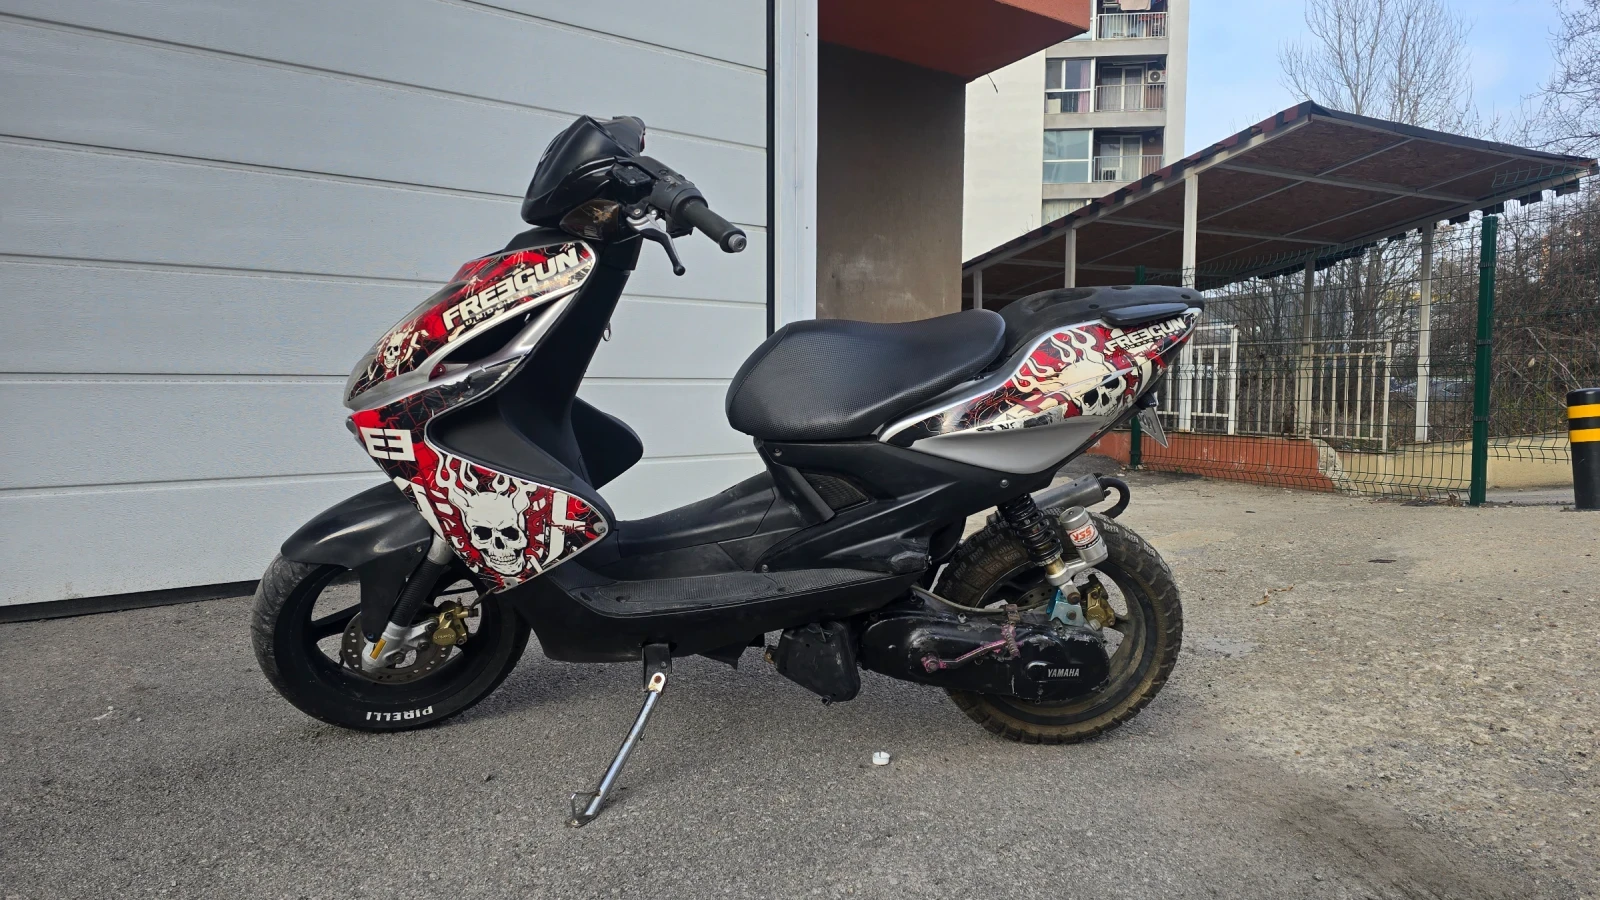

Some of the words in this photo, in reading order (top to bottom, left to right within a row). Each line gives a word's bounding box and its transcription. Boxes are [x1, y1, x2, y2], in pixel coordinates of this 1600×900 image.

[442, 247, 579, 330] FREEGUN
[1104, 317, 1187, 352] FREEGUN
[1047, 668, 1080, 678] YAMAHA
[366, 705, 434, 721] PIRELLI
